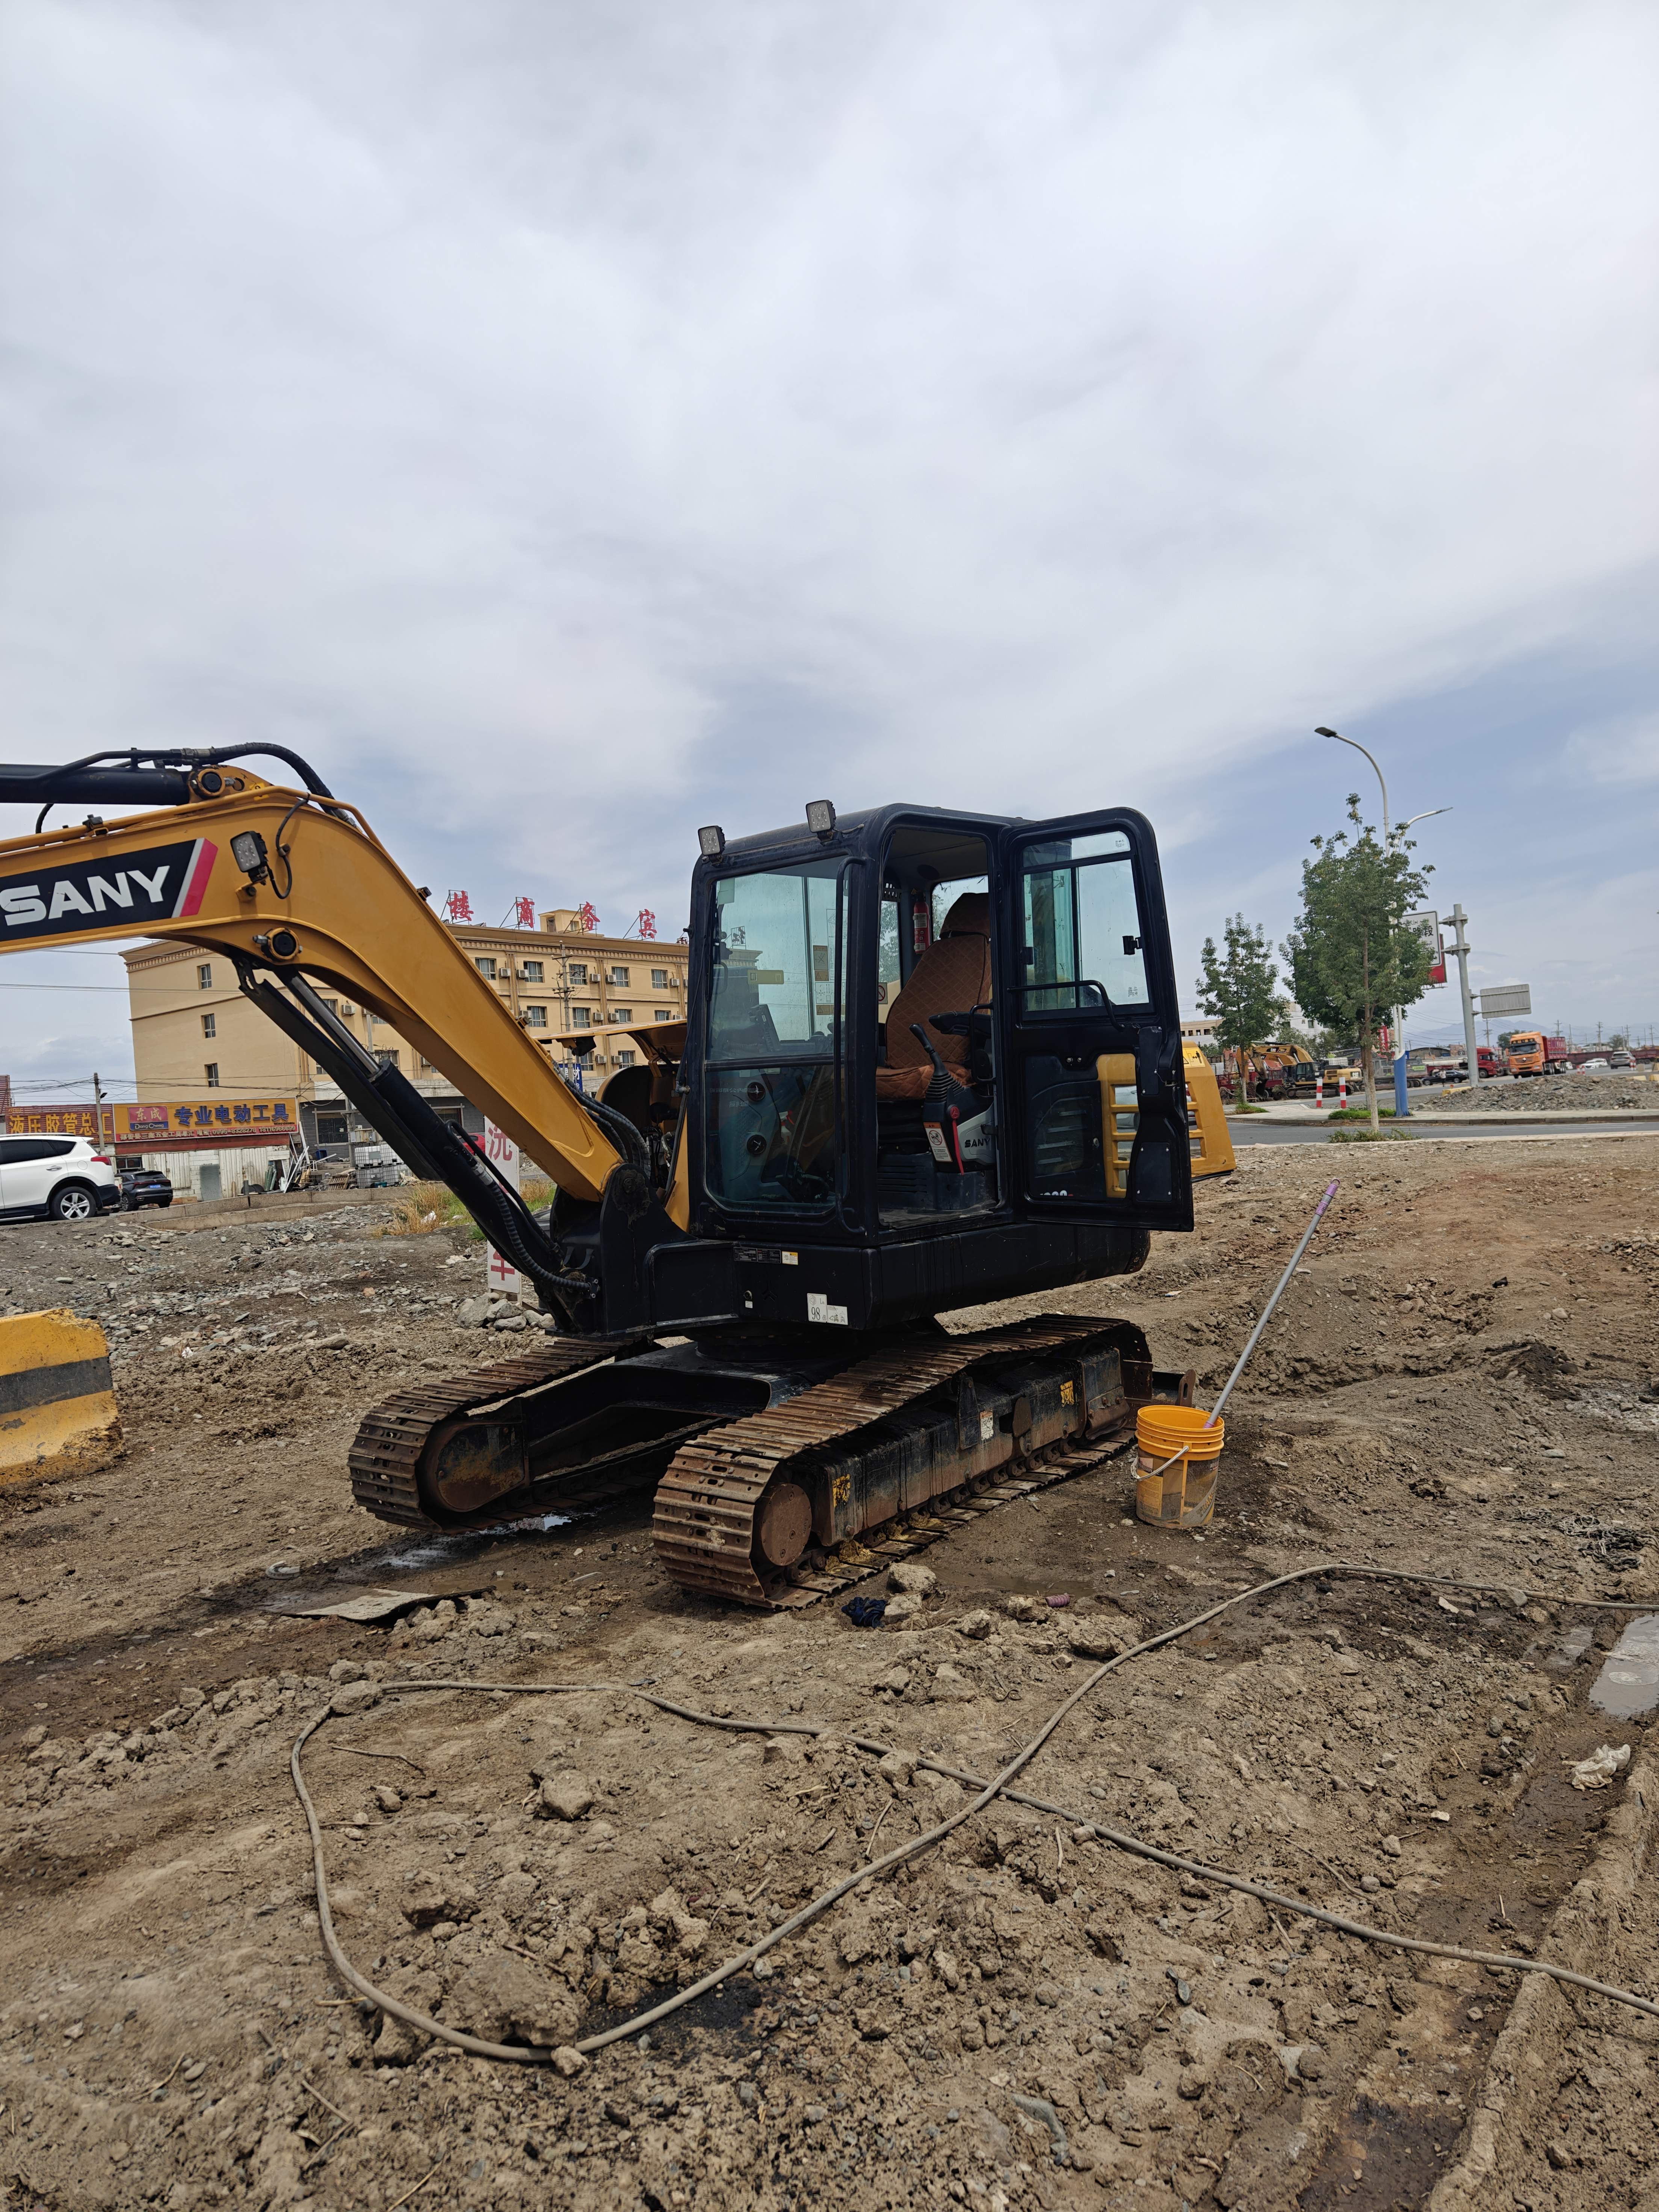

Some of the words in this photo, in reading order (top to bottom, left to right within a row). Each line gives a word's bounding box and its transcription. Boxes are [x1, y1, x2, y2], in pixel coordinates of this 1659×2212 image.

[0, 865, 170, 926] SANY
[135, 1107, 162, 1121] 东成
[174, 1103, 289, 1126] 专业电动工具
[964, 1138, 990, 1148] SANY
[488, 1123, 515, 1281] 洗车
[811, 1307, 820, 1321] 98
